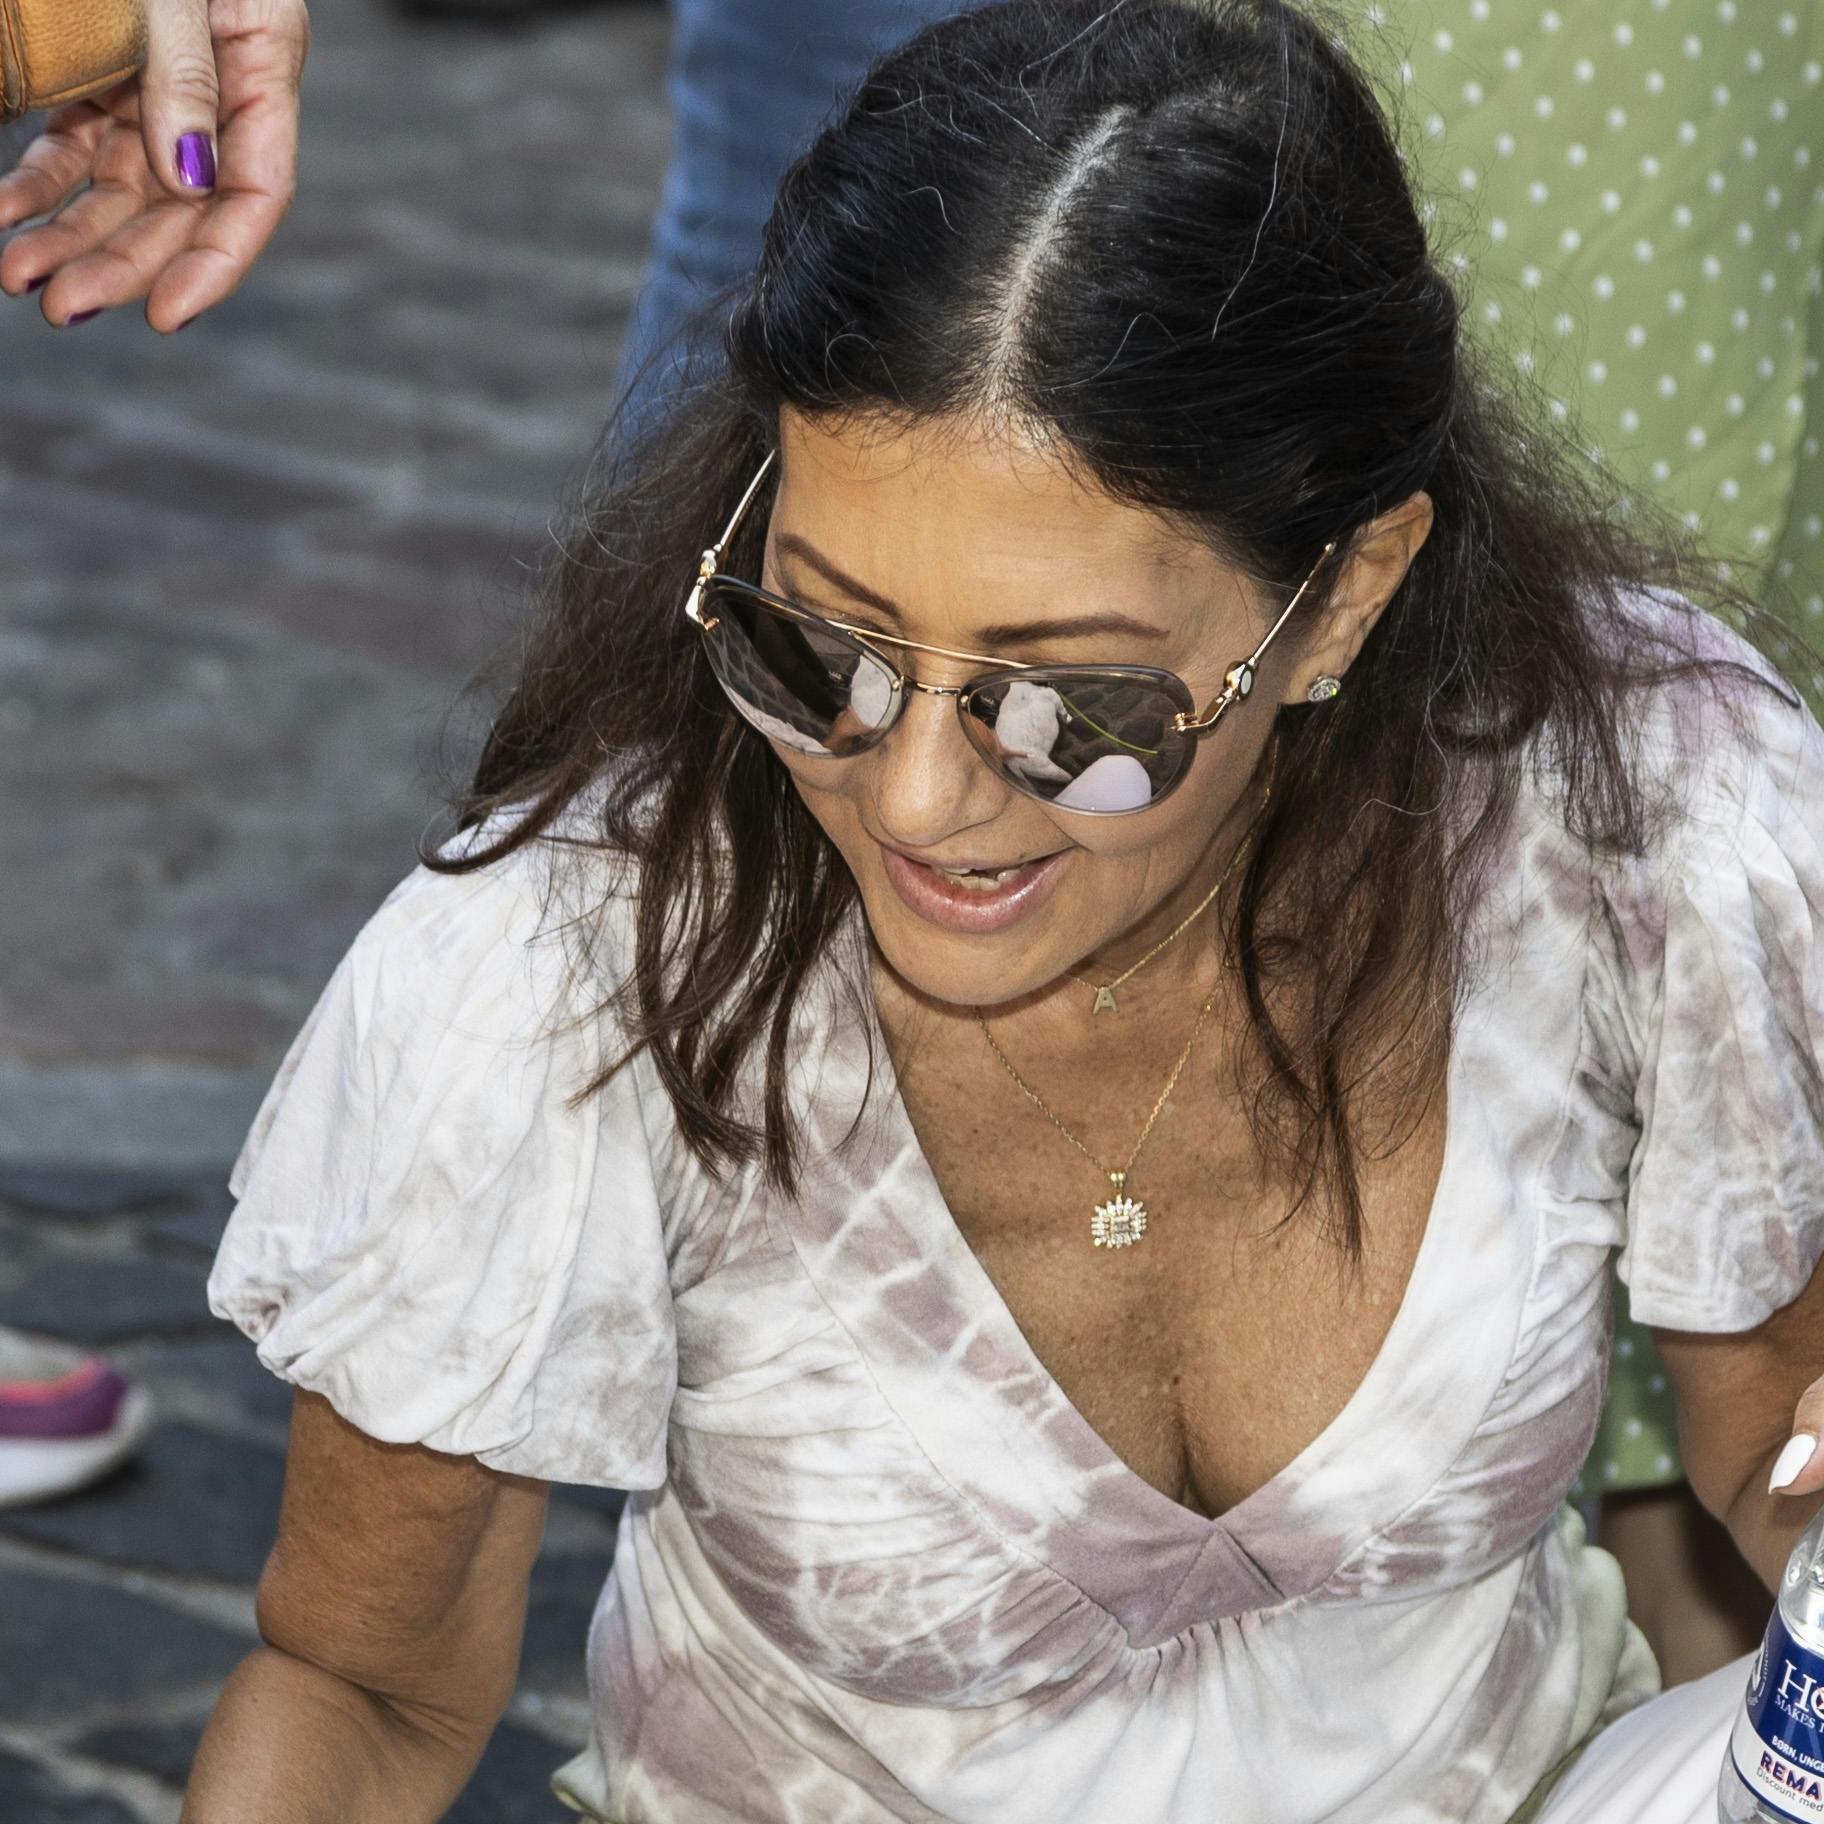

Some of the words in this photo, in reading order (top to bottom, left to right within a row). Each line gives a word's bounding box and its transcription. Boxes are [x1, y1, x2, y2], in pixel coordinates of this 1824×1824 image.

[1093, 986, 1117, 1014] A
[1776, 1694, 1816, 1728] MAKES
[1771, 1735, 1798, 1761] BØRN,
[1756, 1767, 1797, 1800] Discount
[1799, 1798, 1824, 1812] med
[1760, 1750, 1823, 1801] REMA
